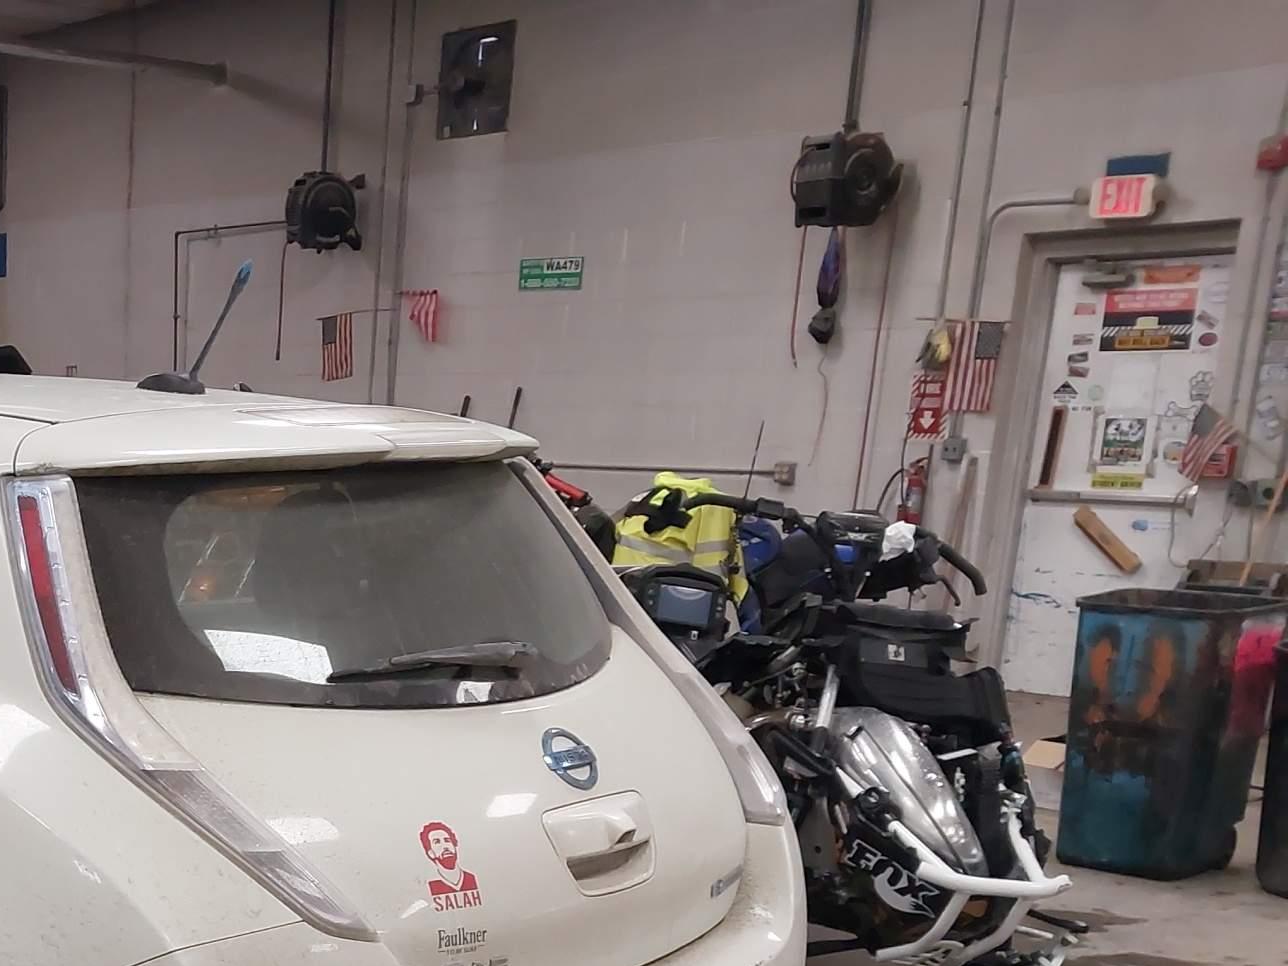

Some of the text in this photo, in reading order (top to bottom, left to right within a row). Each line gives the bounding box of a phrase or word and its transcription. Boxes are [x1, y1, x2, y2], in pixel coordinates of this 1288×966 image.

[1099, 176, 1147, 216] EXIT
[545, 259, 581, 272] WA479
[844, 839, 941, 918] FOX
[433, 890, 483, 912] SALAH
[437, 927, 488, 949] Faulkner
